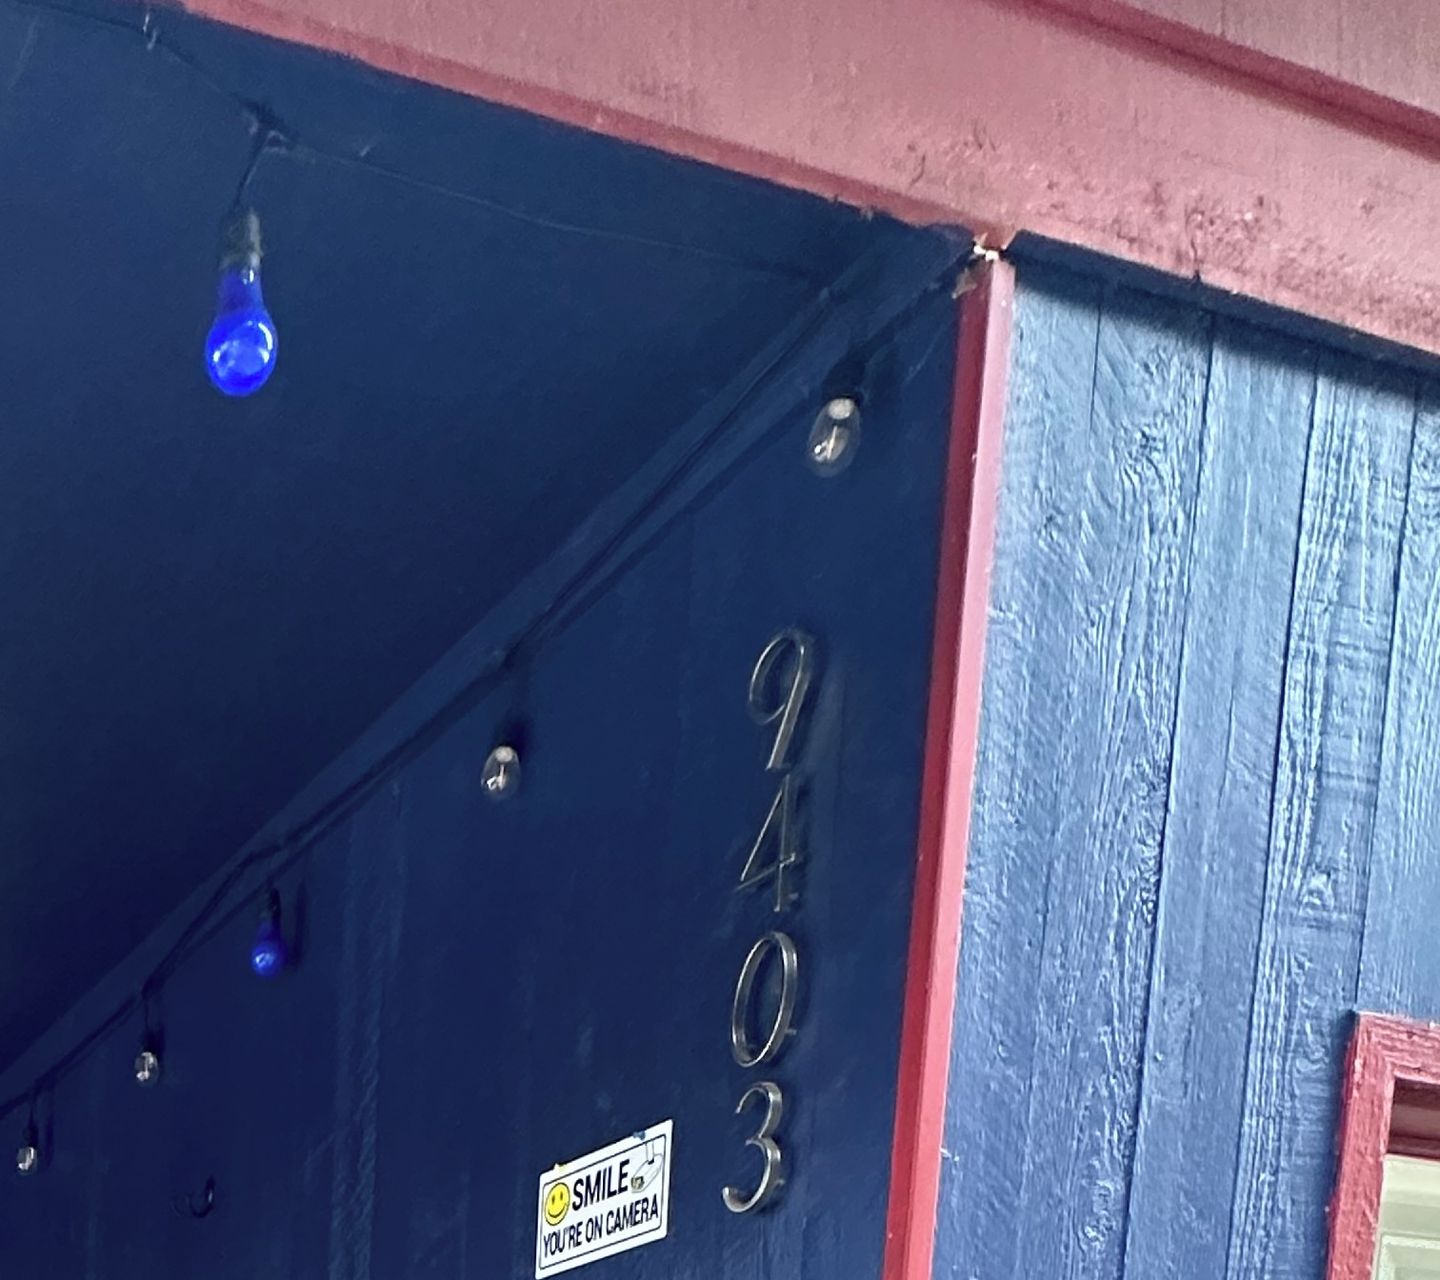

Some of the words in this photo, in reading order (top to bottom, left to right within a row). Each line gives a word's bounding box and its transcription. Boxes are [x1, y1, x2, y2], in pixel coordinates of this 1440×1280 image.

[721, 631, 811, 1214] 9403
[572, 1159, 630, 1211] SMILE
[544, 1221, 583, 1258] YOU'RE
[585, 1214, 603, 1243] ON
[606, 1194, 659, 1236] CAMERA
